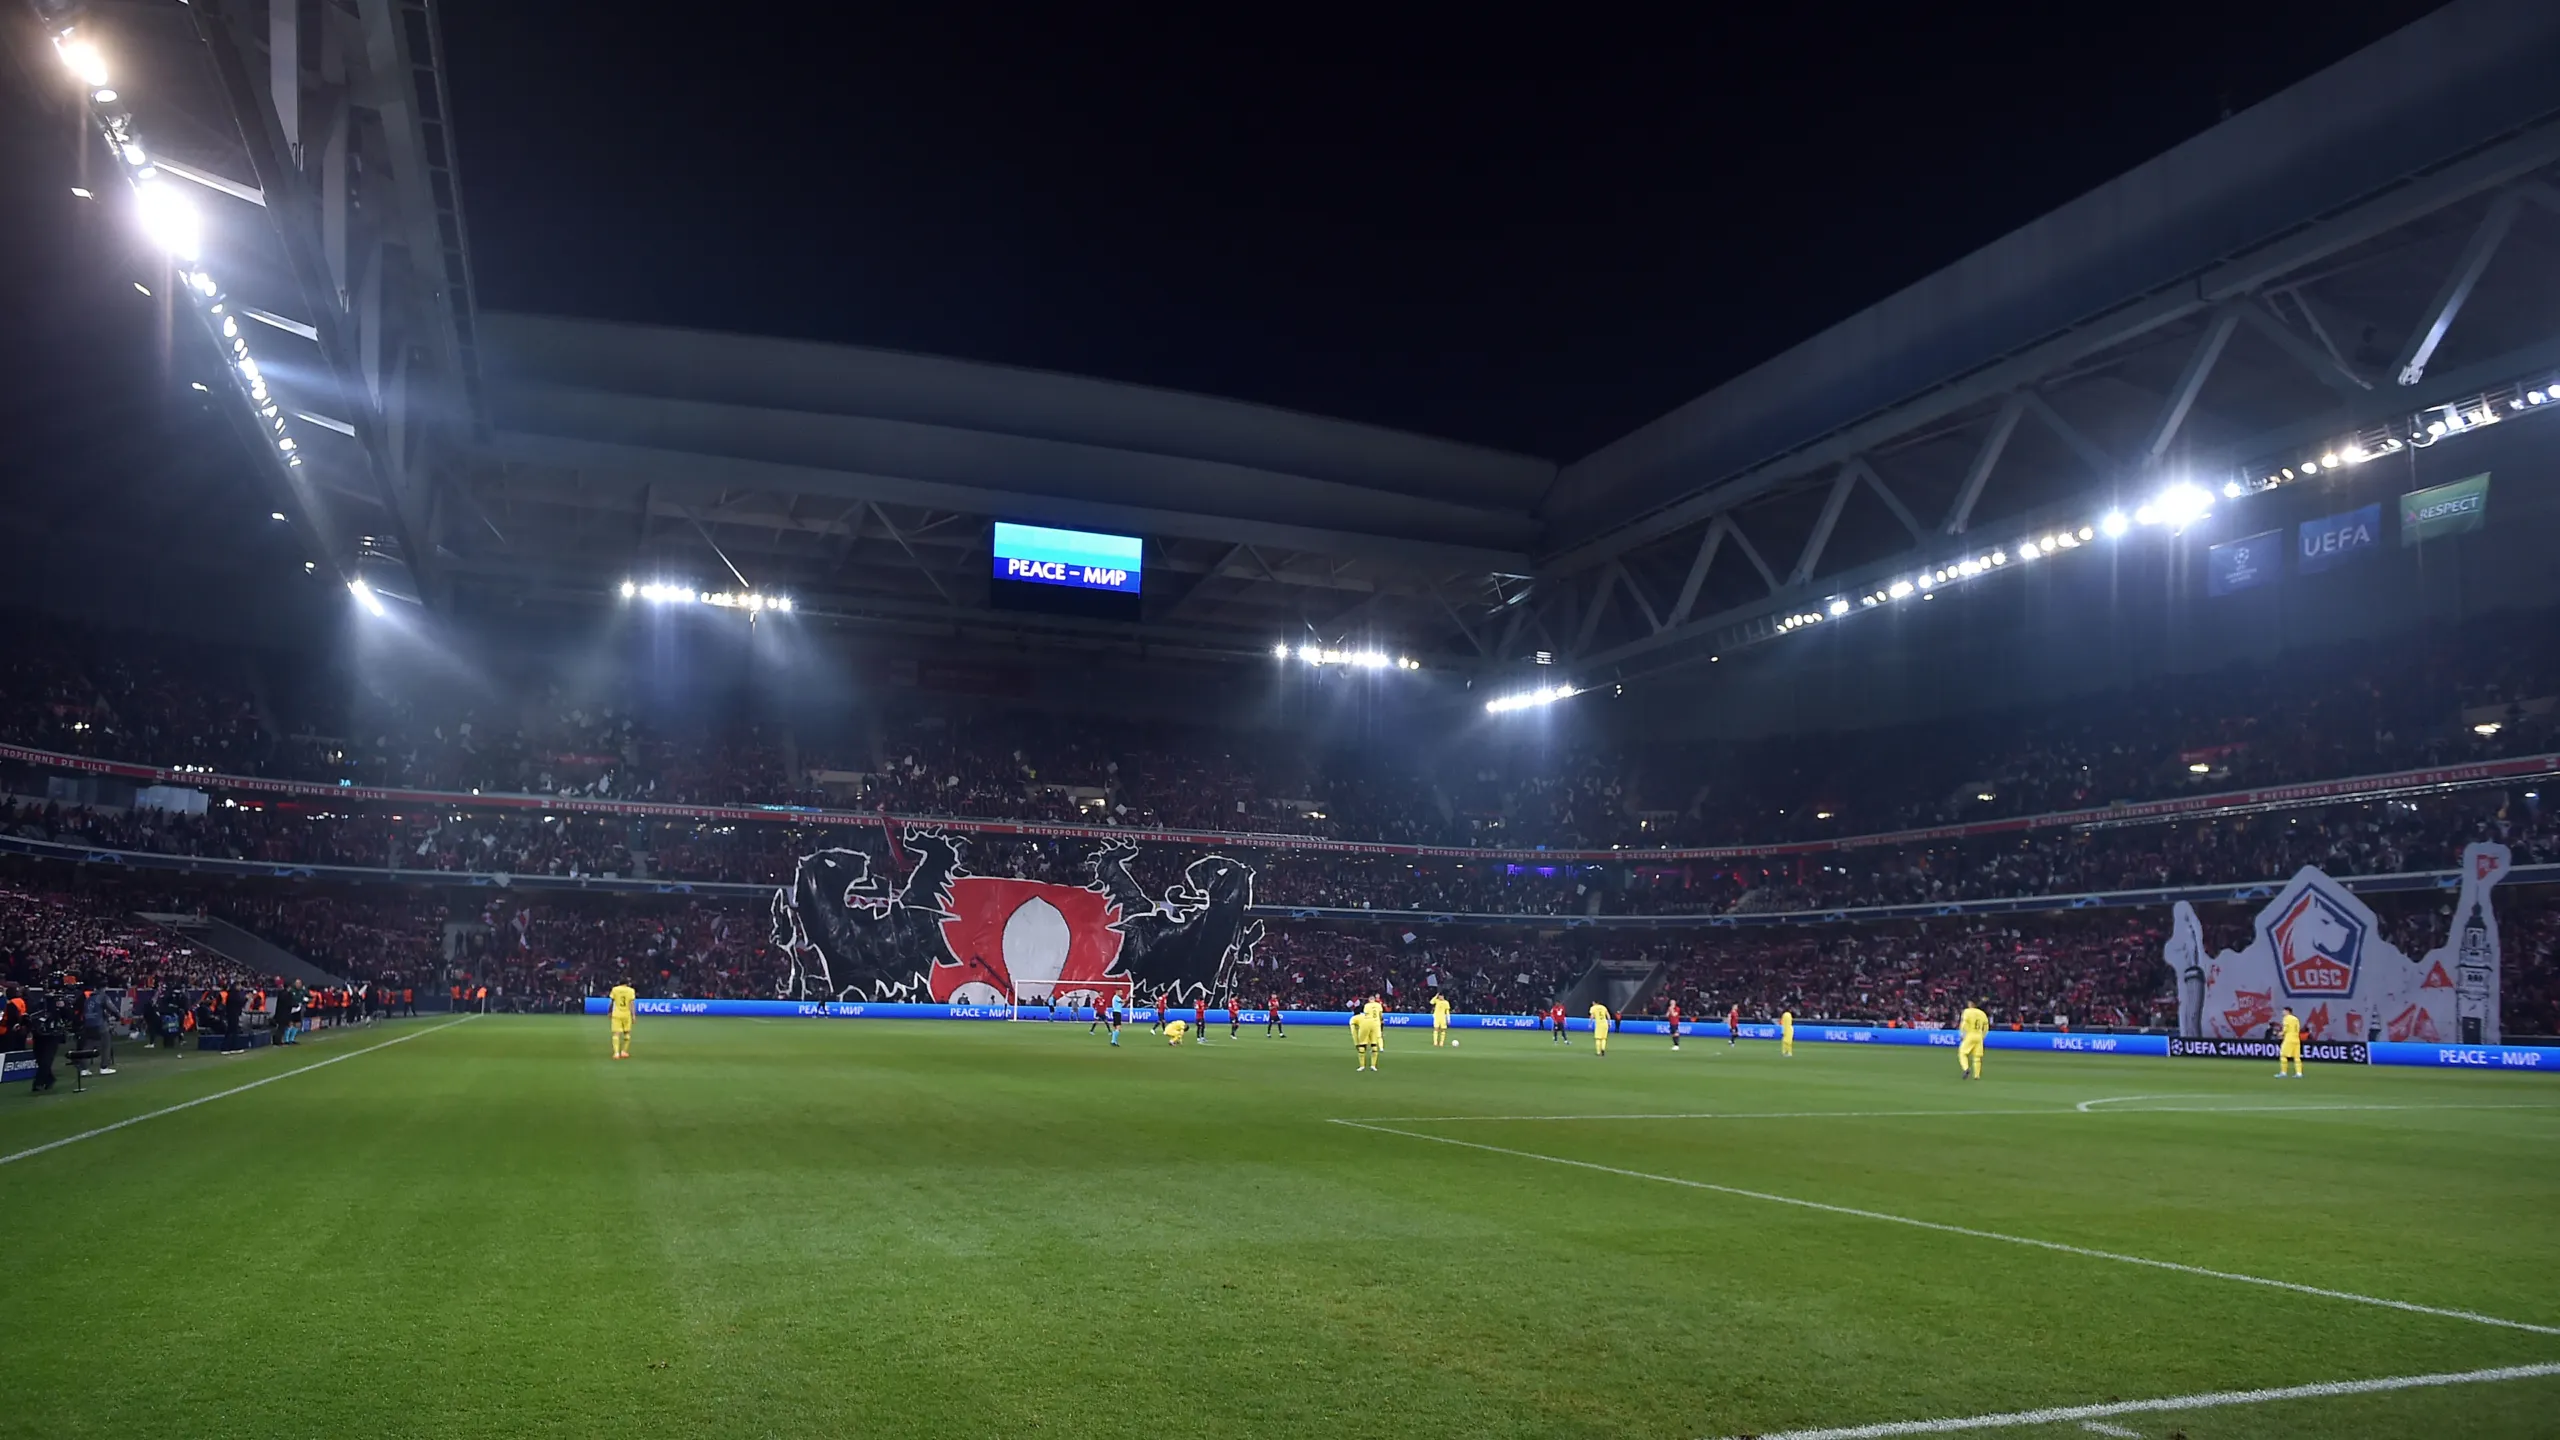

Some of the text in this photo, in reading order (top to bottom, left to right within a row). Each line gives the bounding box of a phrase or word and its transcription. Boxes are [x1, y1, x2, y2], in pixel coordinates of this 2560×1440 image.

[2419, 497, 2479, 520] RESPECT
[2304, 524, 2371, 556] UEFA
[1008, 558, 1066, 580] PEACE
[1083, 566, 1127, 586] МИР
[61, 759, 74, 768] DE
[81, 763, 112, 772] LILLE
[356, 790, 387, 799] LILLE
[2293, 969, 2342, 986] LOSC
[638, 1002, 671, 1012] PEACE
[681, 1002, 708, 1012] МИР
[840, 1006, 864, 1015] МИР
[950, 1007, 980, 1017] PEACE
[1390, 1016, 1410, 1024] МИР
[1482, 1018, 1508, 1026] PEACE
[1514, 1018, 1534, 1027] МИР
[1825, 1030, 1848, 1040] PEACE
[1930, 1034, 1956, 1044] PEACE
[2053, 1038, 2084, 1050] PEACE
[2092, 1040, 2116, 1050] МИР
[2184, 1042, 2216, 1054] UEFA
[2220, 1042, 2281, 1056] CHAMPION
[2440, 1050, 2488, 1064] PEACE
[2502, 1052, 2541, 1066] МИР
